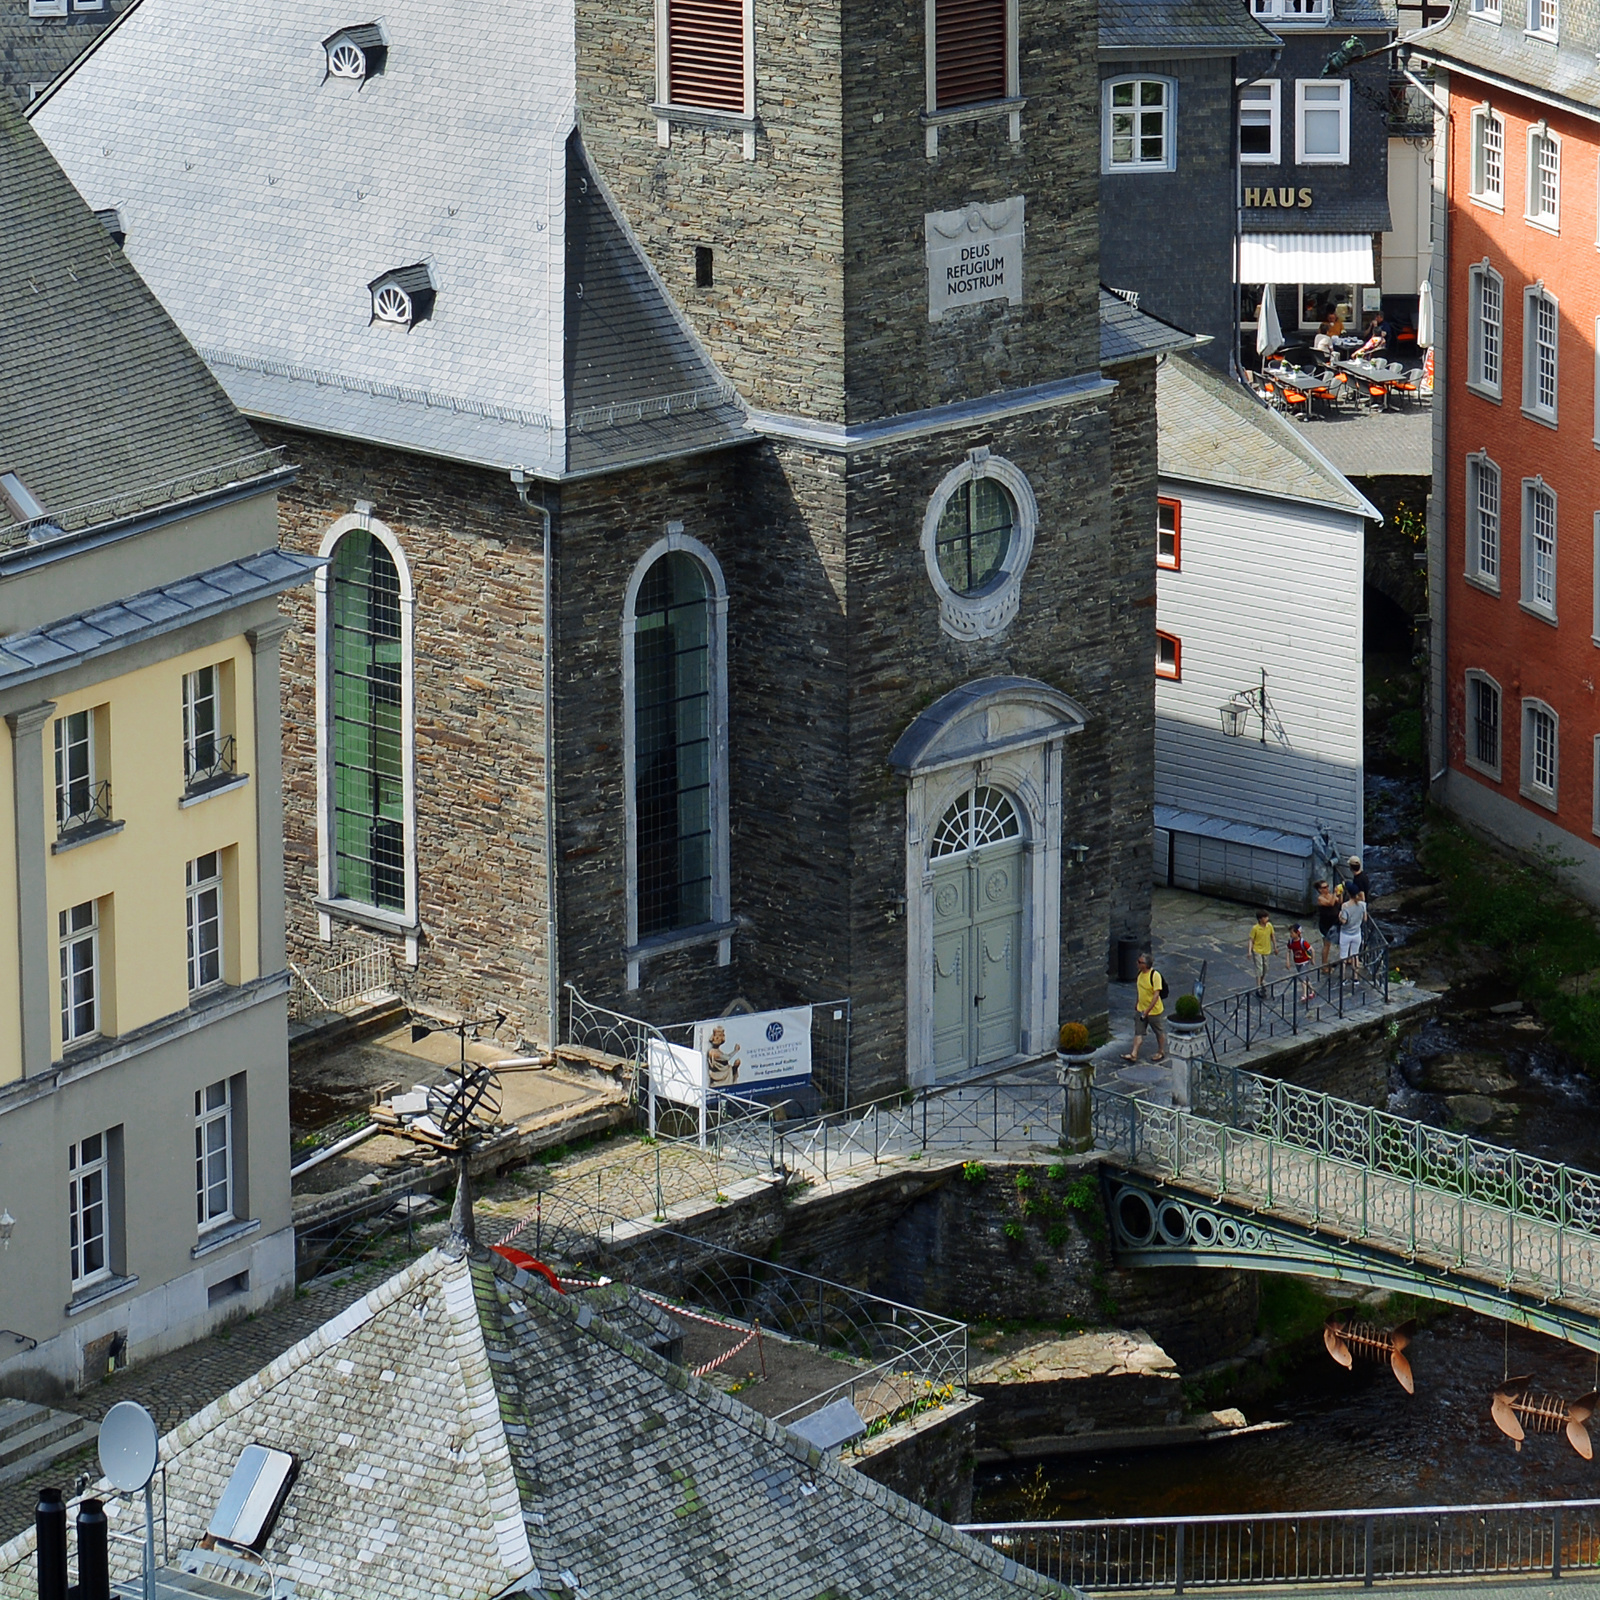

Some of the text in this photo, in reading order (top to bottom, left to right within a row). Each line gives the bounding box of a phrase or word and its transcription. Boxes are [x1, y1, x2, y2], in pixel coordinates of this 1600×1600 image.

[1244, 187, 1313, 208] HAUS
[960, 243, 990, 260] DEUS
[946, 256, 1005, 280] REFUGIUM
[947, 272, 1004, 296] NOSTRUM
